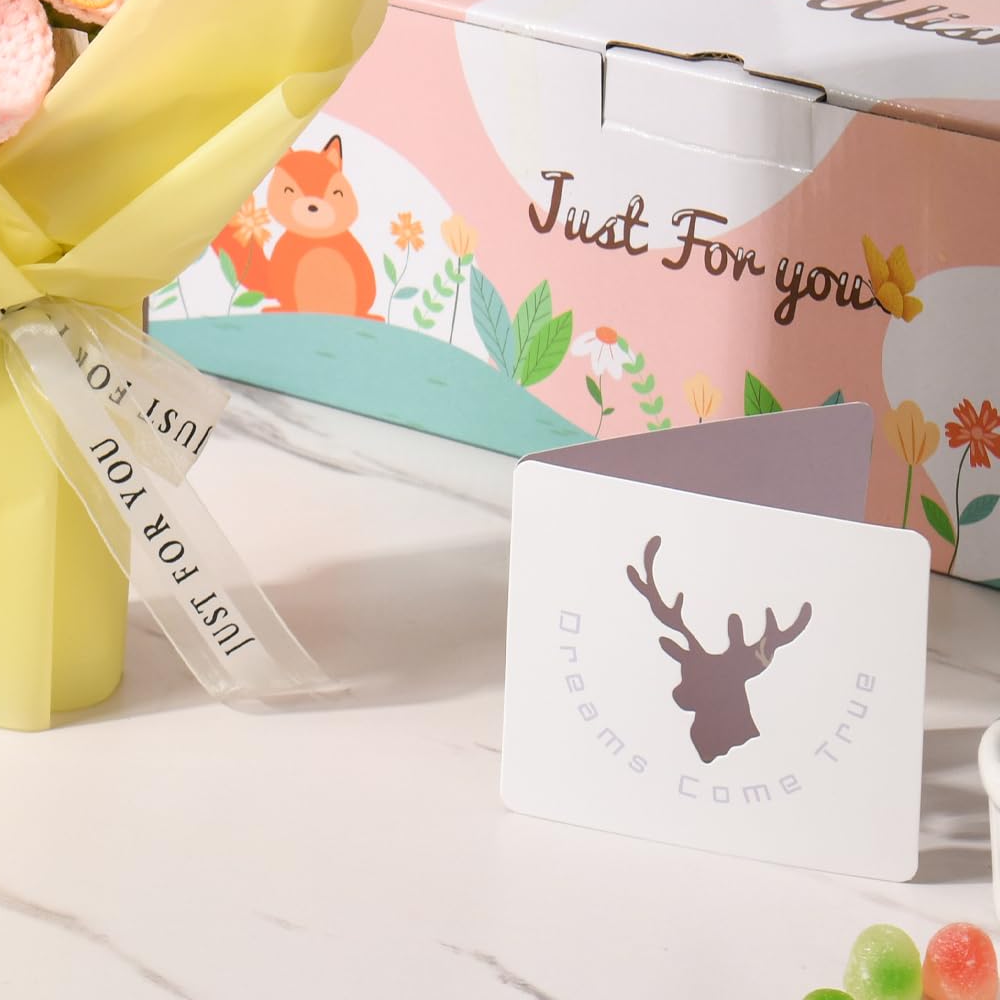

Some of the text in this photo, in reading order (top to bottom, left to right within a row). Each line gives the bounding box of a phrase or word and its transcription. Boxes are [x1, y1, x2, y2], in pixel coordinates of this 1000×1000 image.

[529, 170, 893, 326] Just For you
[89, 437, 256, 656] JUST FOR YOU
[559, 609, 877, 804] Dreams Come True
